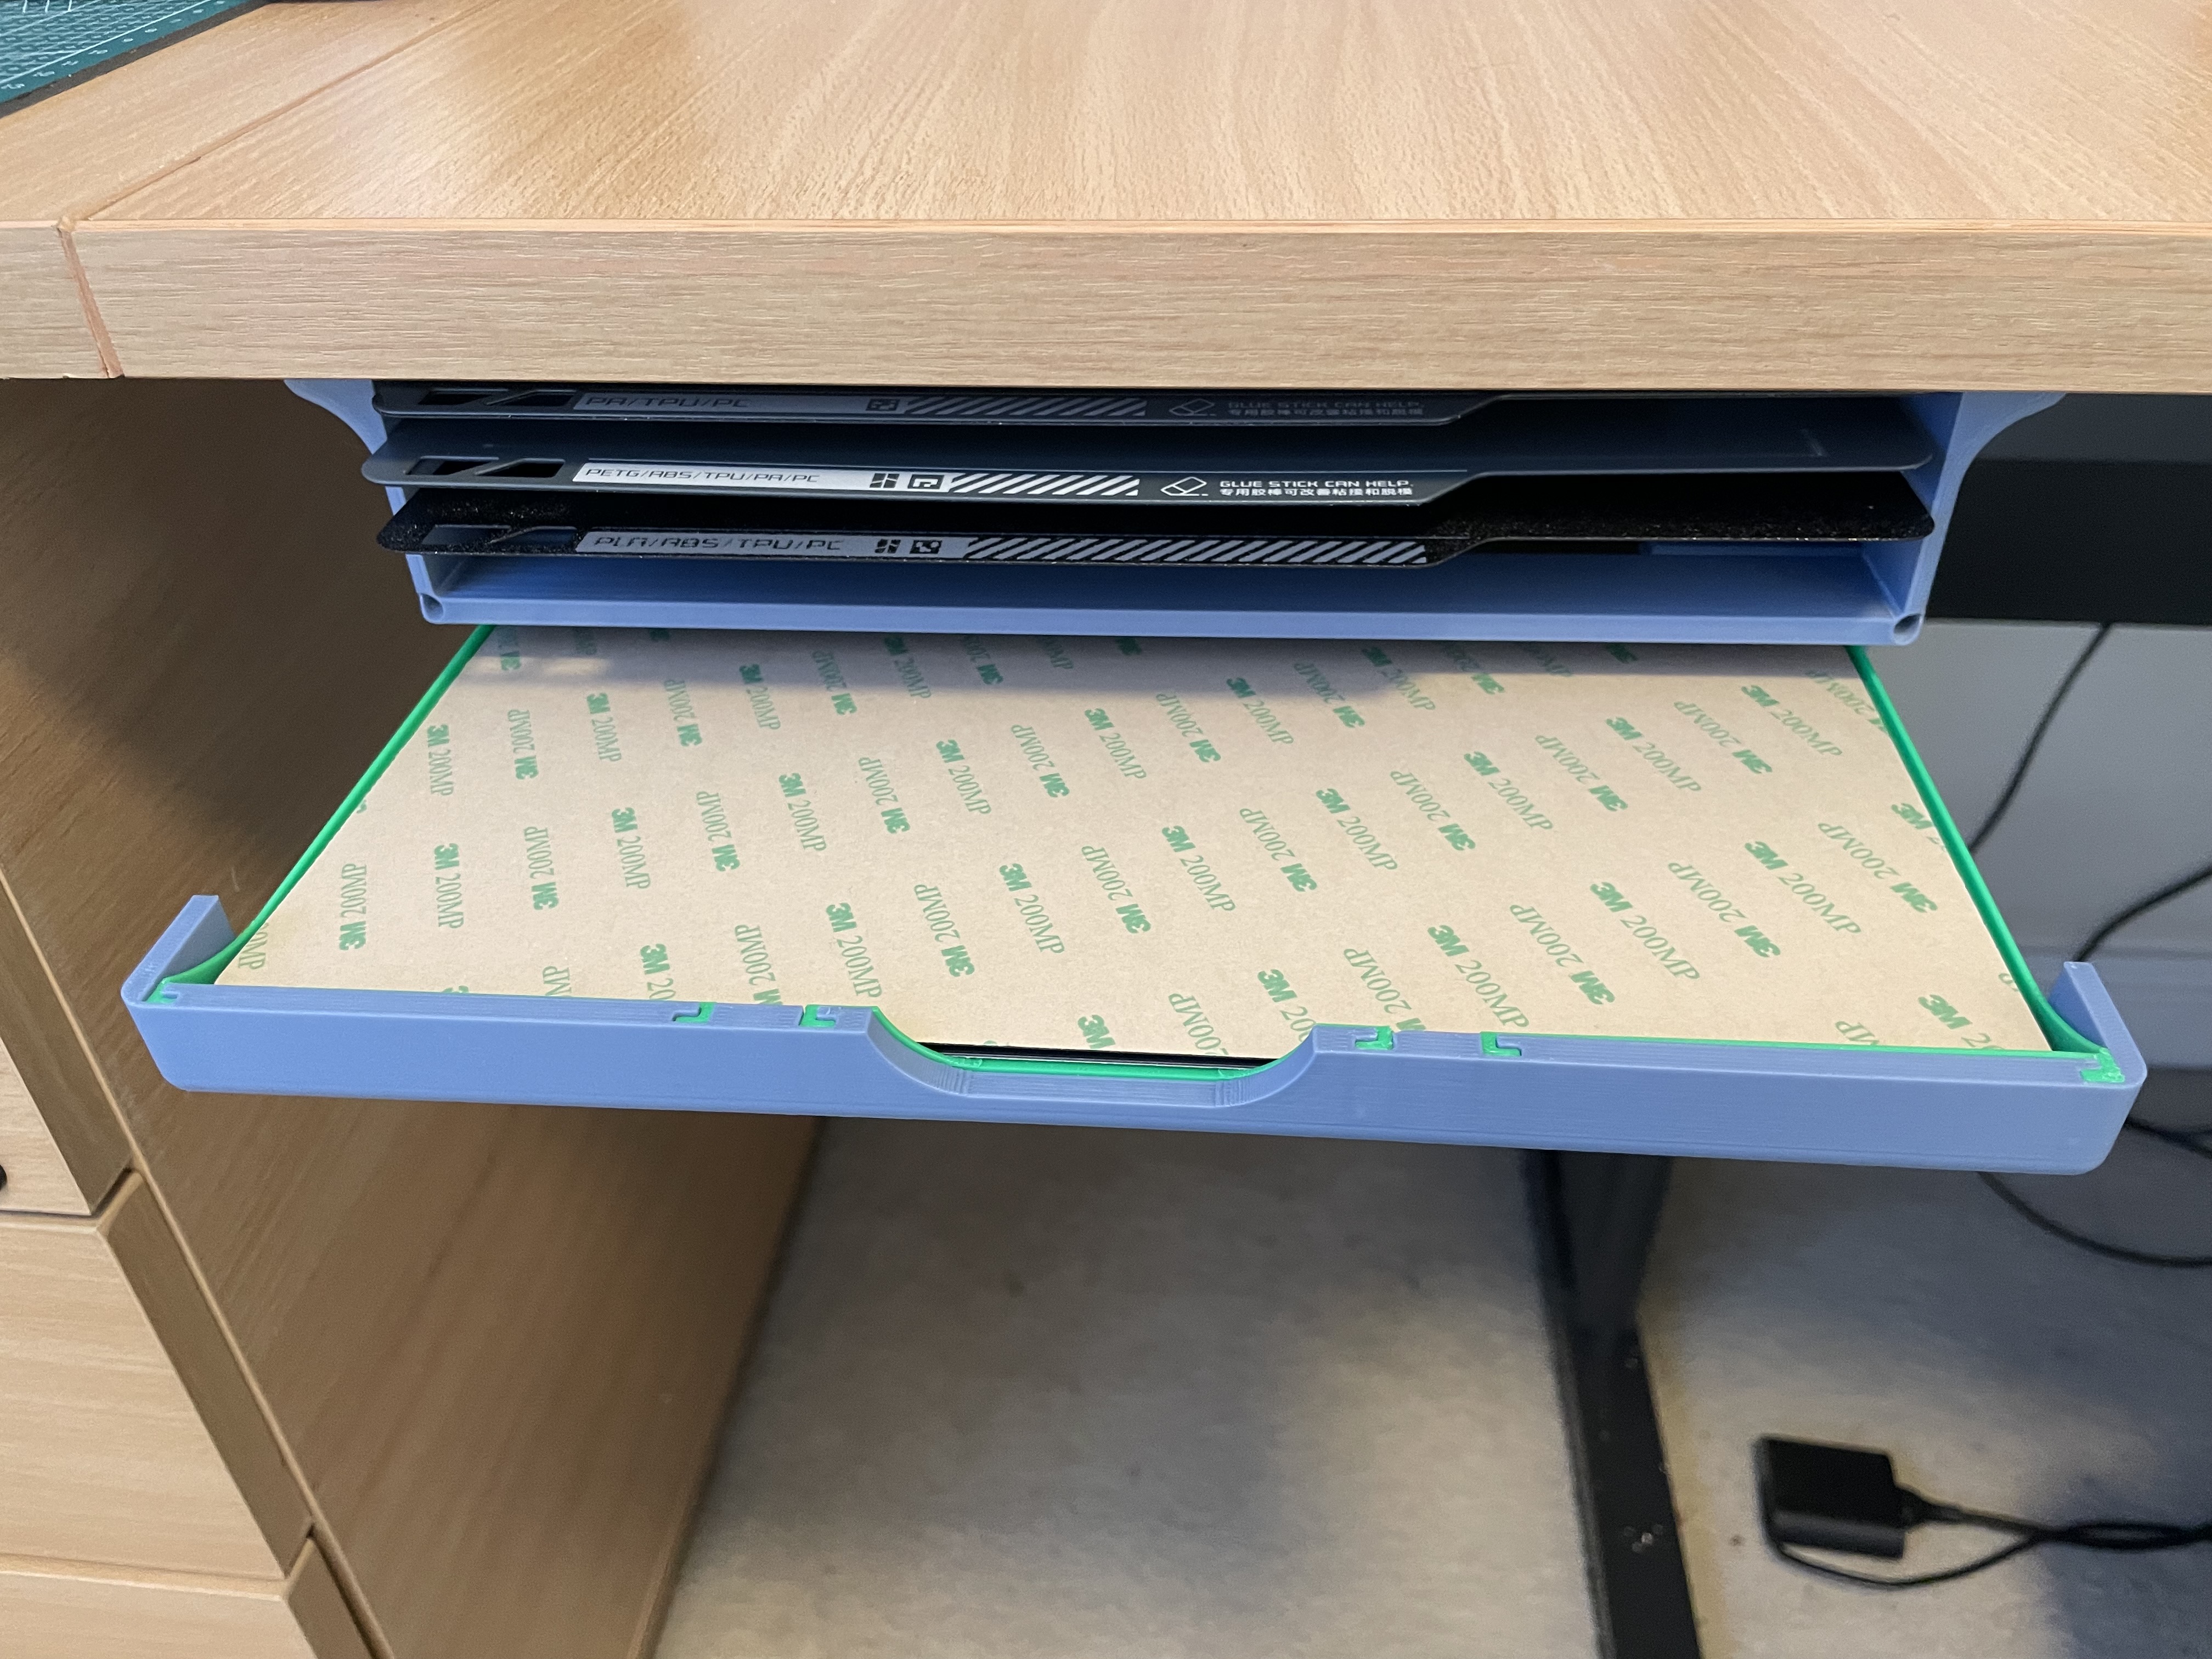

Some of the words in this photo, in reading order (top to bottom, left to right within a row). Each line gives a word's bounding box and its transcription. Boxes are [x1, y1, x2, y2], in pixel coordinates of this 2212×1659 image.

[585, 468, 821, 483] PETG/ABS/TPU/PA/PC
[595, 535, 844, 551] PLA/ABS/TPU/PC
[427, 724, 449, 747] 3M
[1155, 692, 1204, 737] 200MP
[1244, 699, 1295, 745] 200MP
[1673, 702, 1740, 756] 200MP
[1742, 685, 1779, 707] 3M
[1773, 710, 1843, 755] 200MP
[591, 716, 622, 761] 200MP
[936, 739, 964, 764] 3M
[1009, 724, 1057, 771] 200MP
[1085, 708, 1113, 730] 3M
[1100, 733, 1147, 779] 200MP
[1189, 739, 1221, 763] 3M
[1606, 718, 1641, 740] 3M
[1633, 743, 1702, 792] 200MP
[1733, 749, 1772, 774] 3M
[515, 756, 539, 780] 3M
[778, 773, 805, 797] 3M
[857, 757, 899, 806] 200MP
[1040, 773, 1070, 797] 3M
[1535, 735, 1601, 792] 200MP
[948, 765, 992, 815] 200MP
[1389, 770, 1451, 820] 200MP
[1464, 752, 1499, 776] 3M
[1489, 779, 1554, 830] 200MP
[1589, 785, 1628, 811] 3M
[611, 808, 637, 833] 3M
[695, 790, 732, 843] 200MP
[787, 800, 828, 851] 200MP
[881, 808, 910, 834] 3M
[1239, 808, 1295, 861] 200MP
[1316, 788, 1350, 814] 3M
[1338, 816, 1398, 870] 200MP
[1439, 823, 1475, 851] 3M
[434, 844, 459, 870] 3M
[523, 826, 555, 880] 200MP
[616, 835, 652, 890] 200MP
[712, 844, 740, 872] 3M
[1081, 845, 1132, 900] 200MP
[1161, 826, 1195, 853] 3M
[1181, 856, 1236, 911] 200MP
[1817, 822, 1899, 881] 200MP
[340, 862, 368, 917] 200MP
[532, 882, 558, 910] 3M
[1000, 864, 1031, 891] 3M
[1282, 864, 1317, 892] 3M
[1668, 862, 1746, 922] 200MP
[1745, 841, 1787, 870] 3M
[1779, 873, 1861, 934] 200MP
[1891, 882, 1937, 913] 3M
[435, 873, 465, 929] 200MP
[826, 903, 856, 932] 3M
[913, 884, 961, 942] 200MP
[1116, 904, 1150, 934] 3M
[340, 922, 366, 950] 3M
[1014, 895, 1065, 954] 200MP
[1509, 904, 1583, 968] 200MP
[1590, 882, 1632, 912] 3M
[1621, 916, 1700, 980] 200MP
[1735, 926, 1781, 958] 3M
[640, 944, 670, 974] 3M
[733, 924, 776, 985] 200MP
[837, 936, 882, 998] 200MP
[941, 945, 974, 977] 3M
[1428, 925, 1468, 956] 3M
[1455, 960, 1530, 1027] 200MP
[1257, 969, 1296, 1003] 3M
[1344, 949, 1412, 1014] 200MP
[1571, 970, 1615, 1005] 3M
[1077, 1015, 1115, 1051] 3M
[1918, 994, 1970, 1029] 3M
